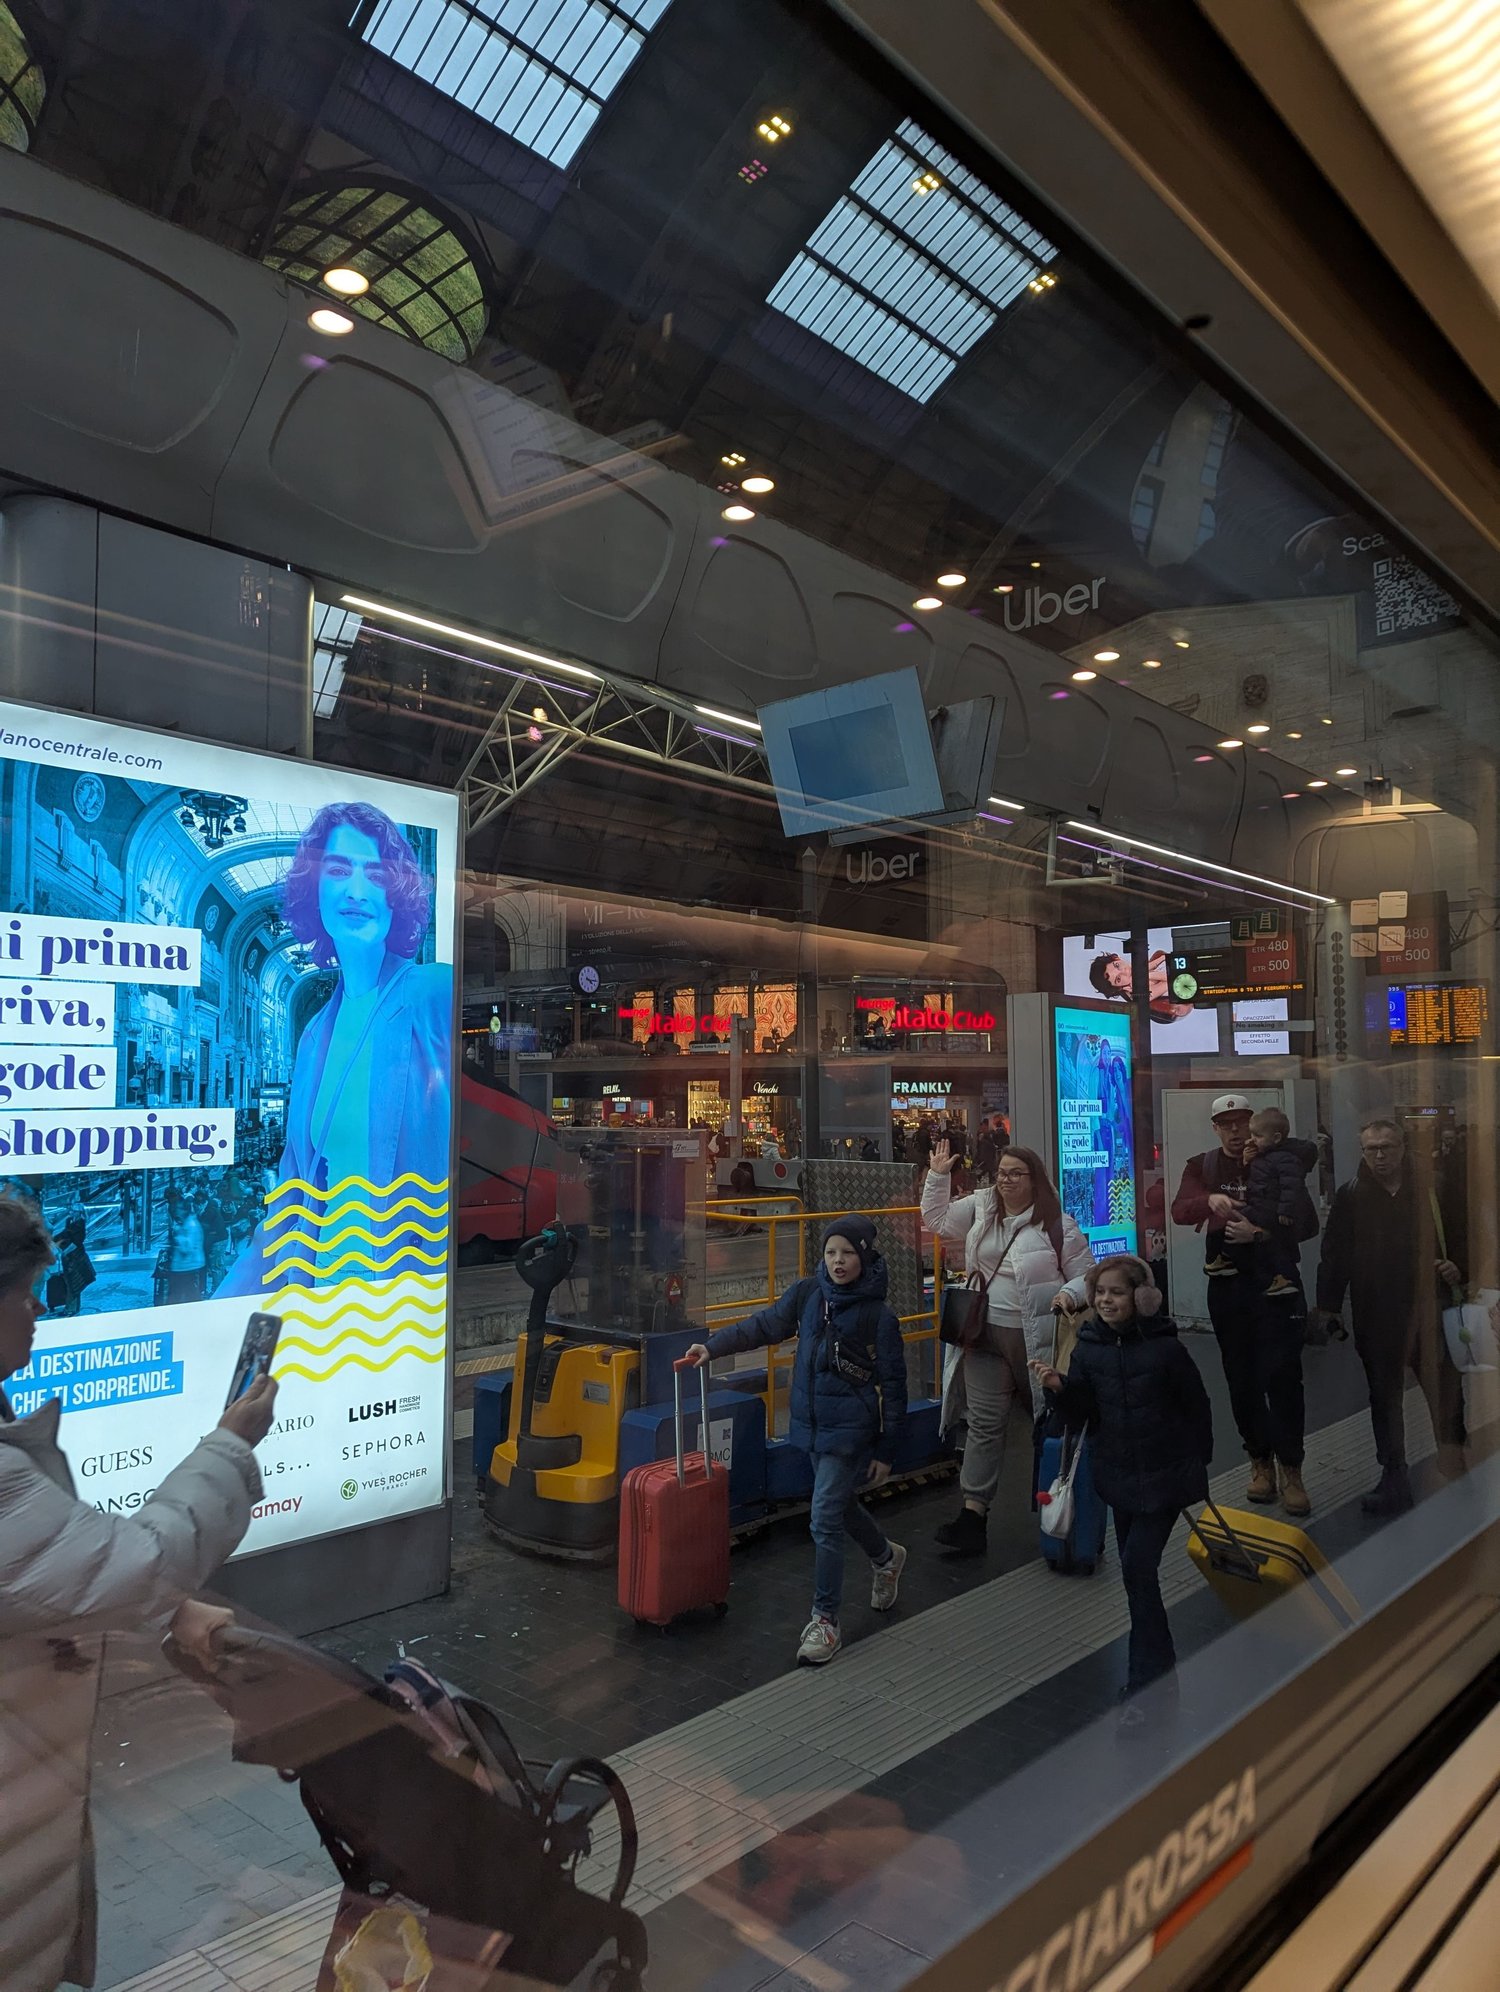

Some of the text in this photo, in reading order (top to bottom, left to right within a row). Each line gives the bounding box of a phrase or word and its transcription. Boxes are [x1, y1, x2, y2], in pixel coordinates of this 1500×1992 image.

[1003, 577, 1105, 633] Uber
[845, 851, 920, 884] Uber
[36, 927, 192, 977] prima
[1252, 940, 1289, 953] ETR 480
[1386, 948, 1431, 963] ETR 500
[1174, 957, 1186, 970] 13
[1253, 959, 1290, 973] ETR 500
[953, 1010, 996, 1030] Club
[1248, 1021, 1276, 1029] smoking
[893, 1081, 953, 1094] FRANKLY
[1063, 1100, 1100, 1117] Chi prima
[1064, 1137, 1090, 1151] si gode
[40, 1339, 162, 1378] DESTINAZIONE
[72, 1369, 176, 1406] SORPRENDE.
[348, 1395, 421, 1422] LUSH FRESH
[268, 1414, 315, 1436] ARIO
[342, 1431, 426, 1461] SEPHORA
[81, 1446, 153, 1477] GUESS
[362, 1467, 428, 1490] YVES ROCHER
